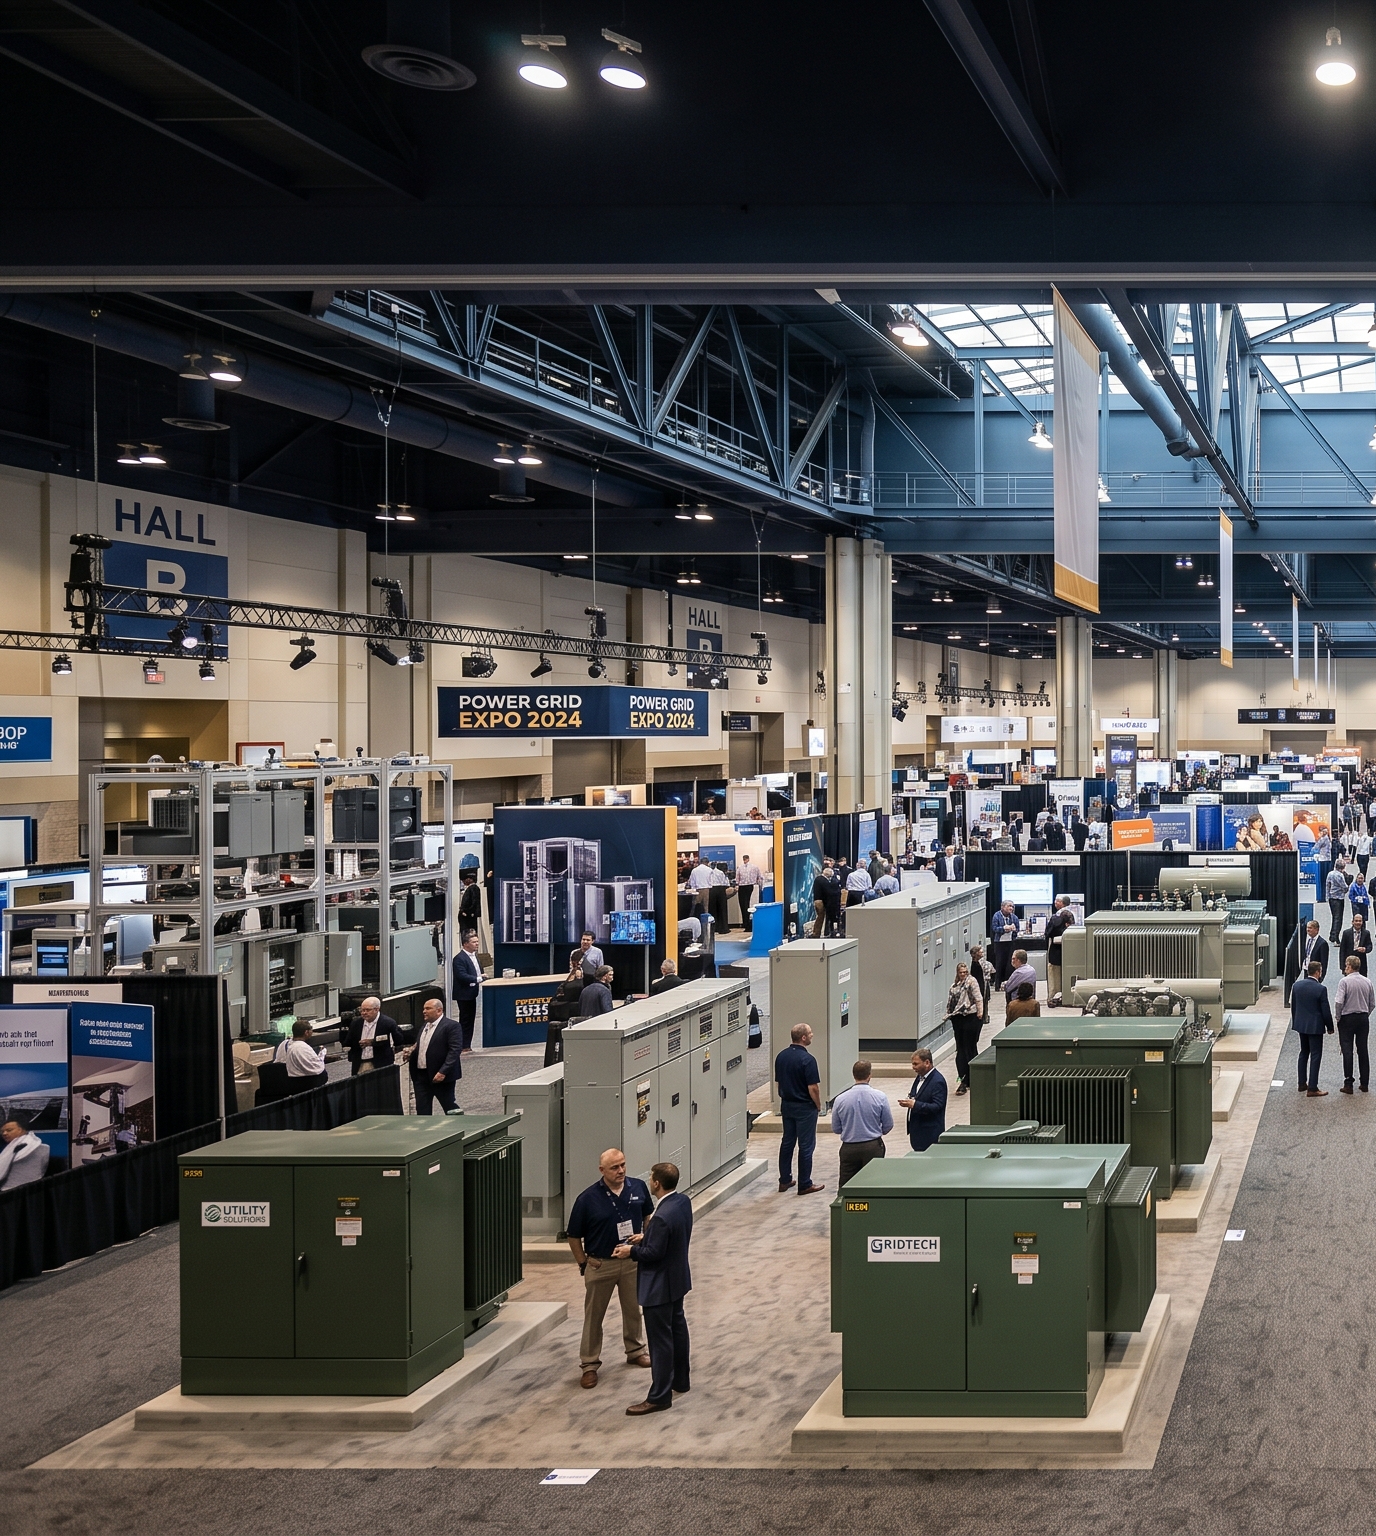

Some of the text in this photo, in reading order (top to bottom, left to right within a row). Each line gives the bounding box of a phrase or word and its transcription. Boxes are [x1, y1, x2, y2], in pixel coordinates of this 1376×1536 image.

[115, 498, 216, 546] HALL
[146, 558, 189, 616] B
[688, 606, 720, 629] HALL
[459, 694, 582, 709] POWER GRID
[629, 695, 694, 711] POWER GRID
[459, 711, 583, 728] EXPO 2024
[630, 711, 695, 728] EXPO 2024
[223, 1205, 267, 1216] UTILITY
[871, 1238, 938, 1254] GRIDTECH
